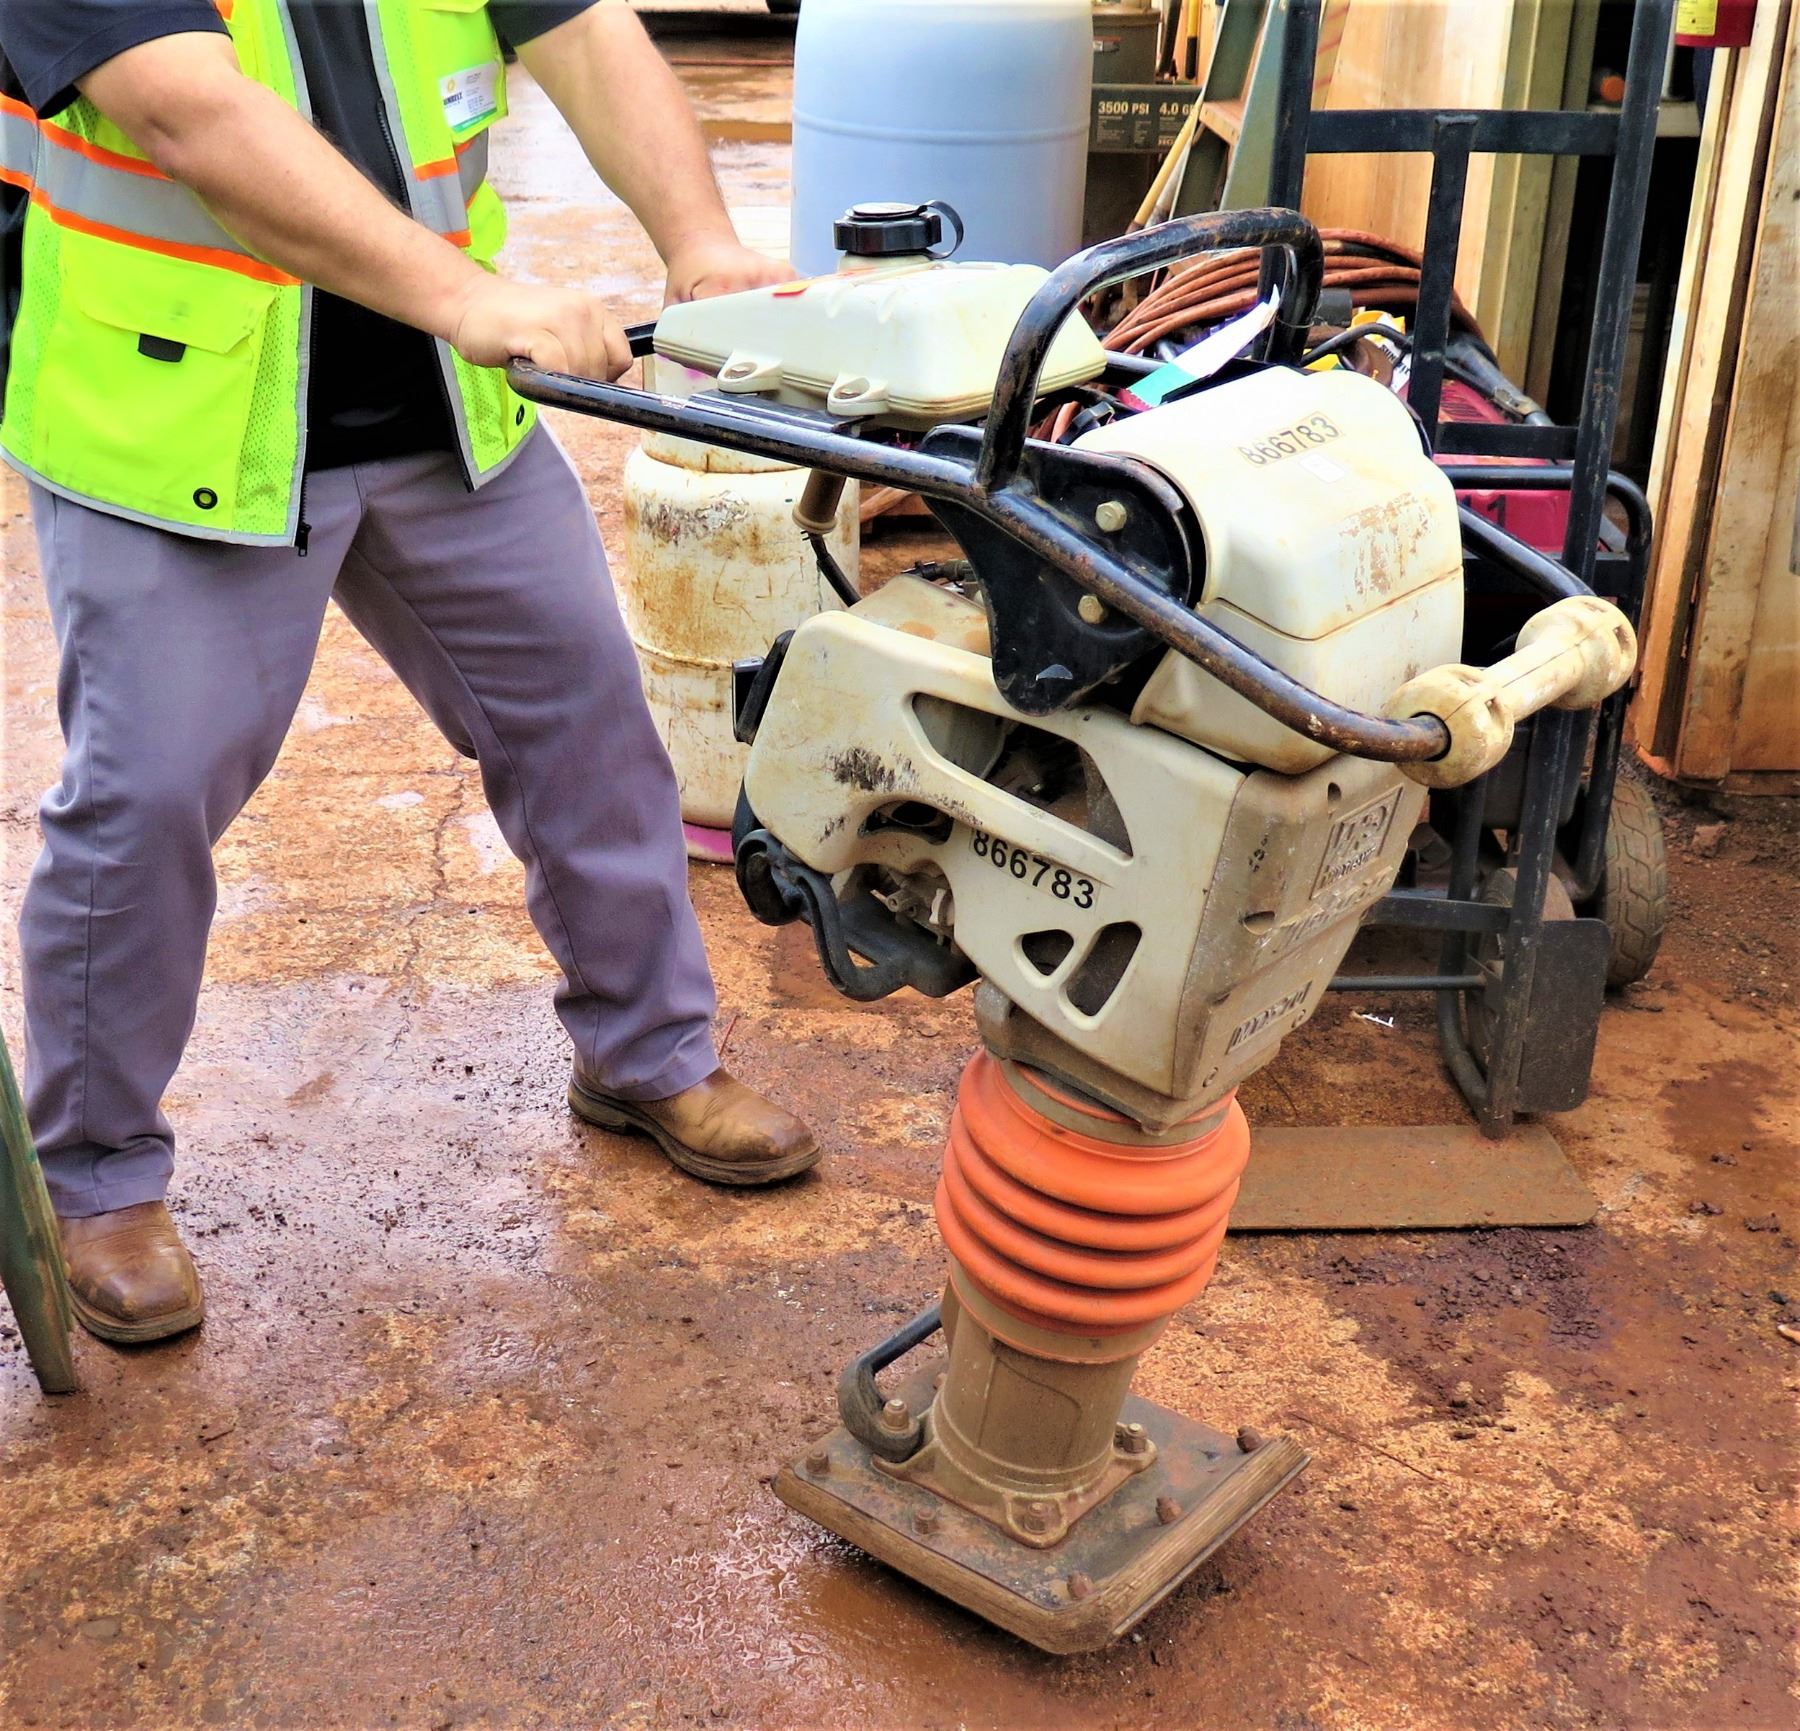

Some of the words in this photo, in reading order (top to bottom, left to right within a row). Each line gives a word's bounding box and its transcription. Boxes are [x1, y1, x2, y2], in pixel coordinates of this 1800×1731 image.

[1098, 101, 1129, 115] 3500
[1131, 103, 1150, 115] PSI
[1159, 102, 1179, 115] 4.0
[1238, 416, 1340, 465] 866783
[973, 829, 1095, 909] 866783
